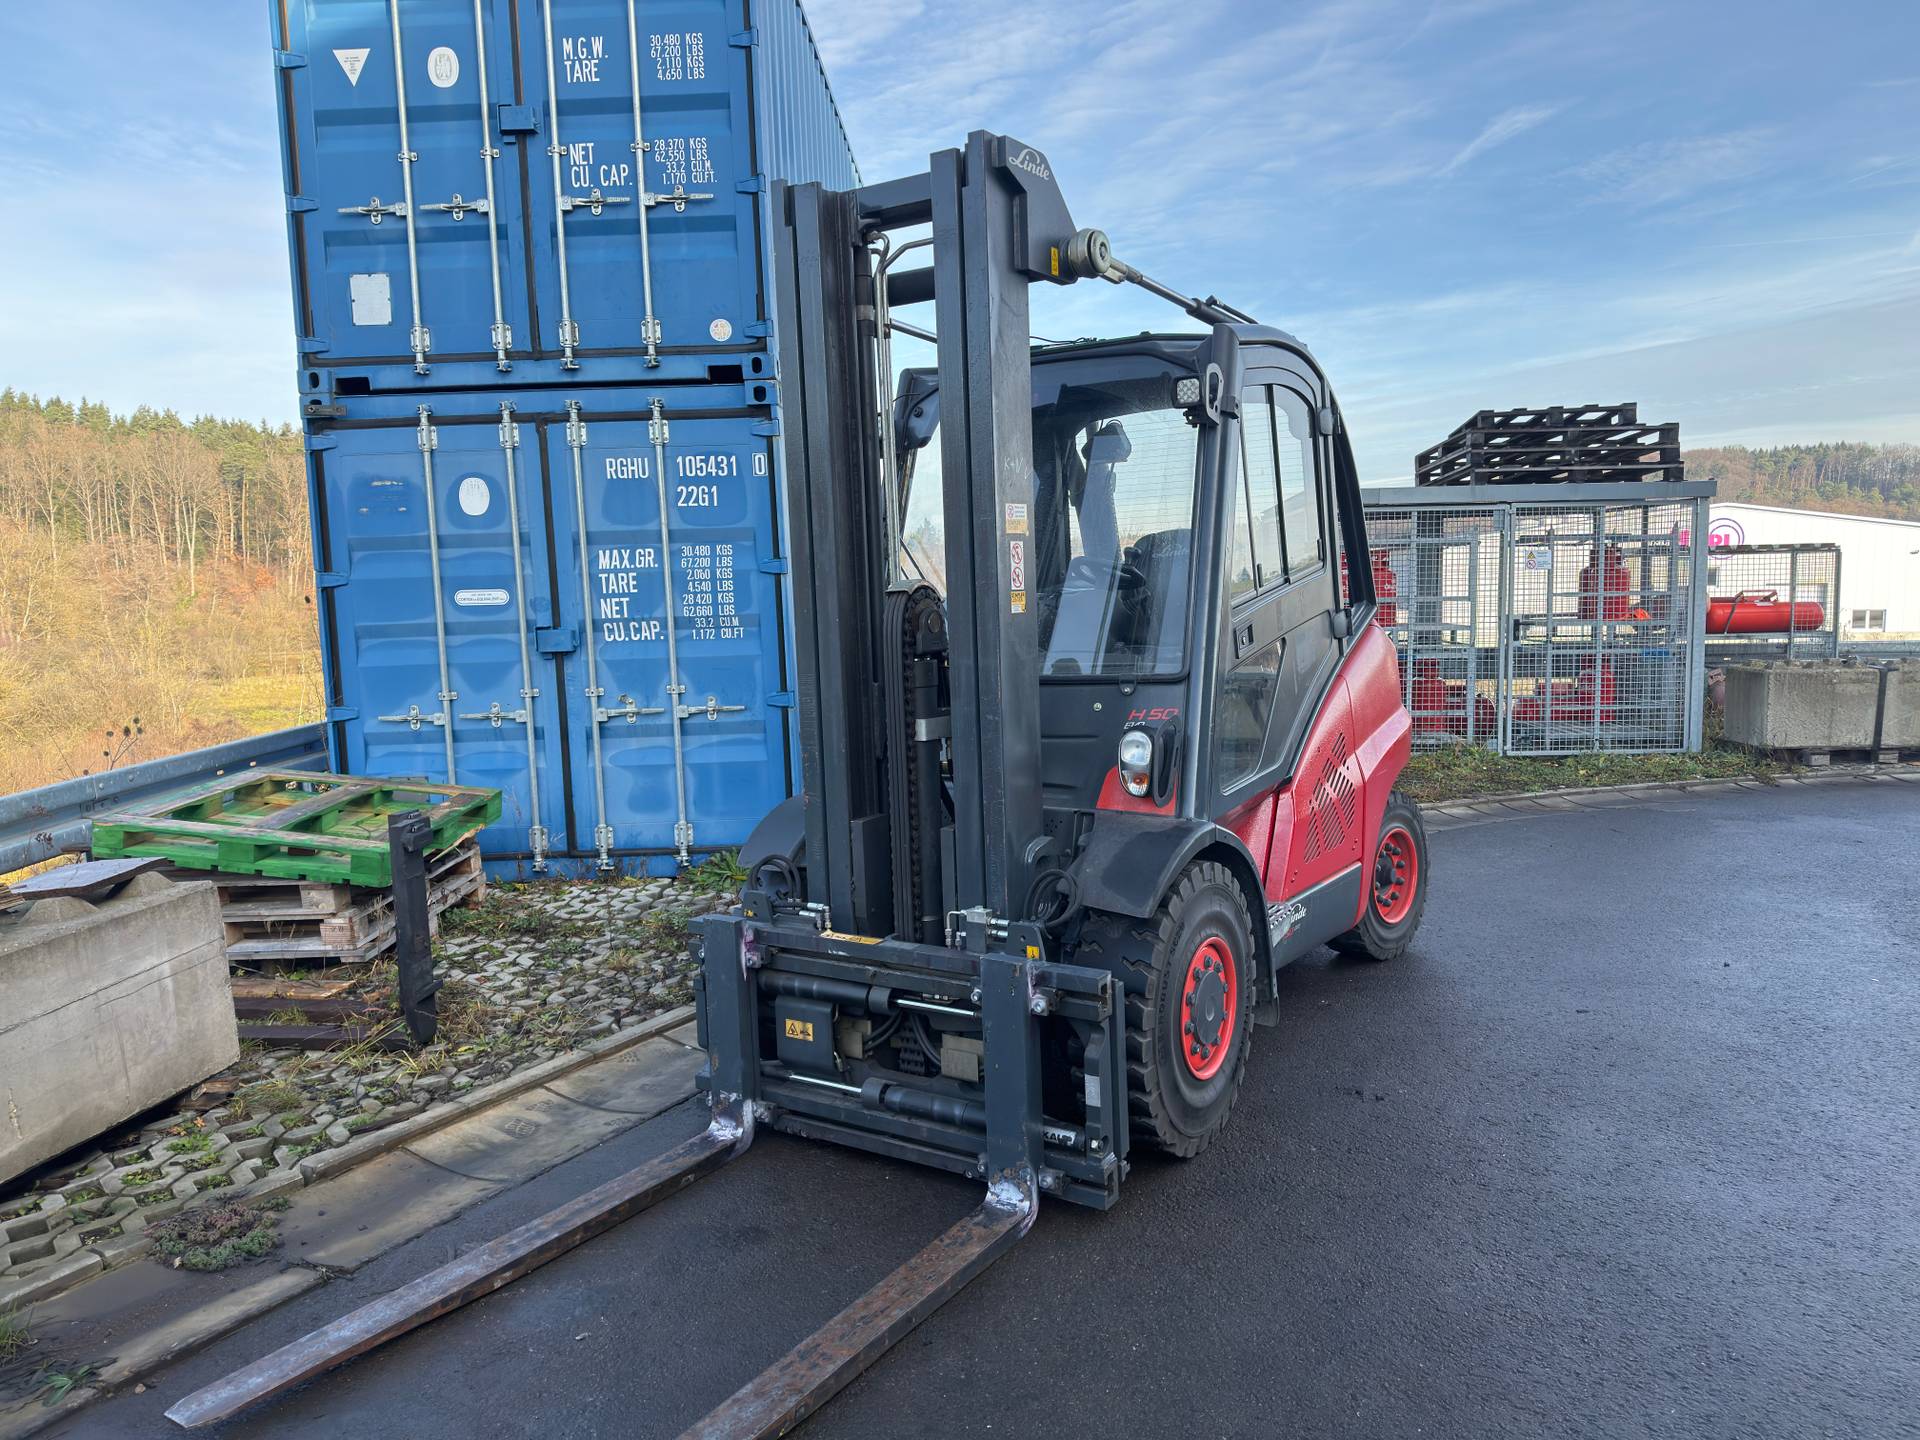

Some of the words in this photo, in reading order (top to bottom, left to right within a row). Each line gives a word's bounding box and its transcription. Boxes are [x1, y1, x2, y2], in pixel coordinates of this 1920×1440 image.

[650, 34, 680, 47] 30.480
[686, 33, 703, 44] KGS
[563, 36, 608, 60] M.G.W.
[651, 46, 680, 59] 67.200
[686, 45, 703, 56] LBS
[657, 58, 681, 70] 2.110
[687, 56, 704, 68] KGS
[564, 60, 599, 82] TARE
[658, 69, 682, 80] 4.650
[688, 67, 704, 79] LBS
[655, 139, 684, 151] 28.370
[690, 138, 706, 150] KGS
[570, 143, 593, 165] NET
[655, 150, 685, 162] 62.550
[690, 149, 707, 161] LBS
[666, 161, 685, 172] 33.2
[1009, 148, 1050, 181] Linde
[572, 166, 593, 187] CU.
[600, 164, 632, 186] CAP.
[663, 172, 686, 184] 1.170
[606, 458, 648, 479] RGHU
[677, 456, 736, 476] 105431
[753, 453, 768, 476] 0
[677, 486, 717, 506] 22G1
[682, 546, 710, 556] 30.480
[717, 545, 732, 555] KGS
[599, 549, 658, 569] MAX.GR.
[682, 558, 710, 568] 67.200
[717, 557, 732, 566] LBS
[687, 569, 710, 579] 2.060
[717, 568, 732, 578] KGS
[599, 573, 637, 593] TARE
[688, 581, 711, 592] 4.540
[717, 580, 733, 591] LBS
[718, 593, 734, 603] KGS
[601, 598, 629, 618] NET
[684, 606, 712, 616] 62.660
[719, 605, 734, 615] LBS
[695, 618, 713, 627] 33.2
[604, 621, 663, 641] CU.CAP.
[693, 629, 714, 639] 1.172
